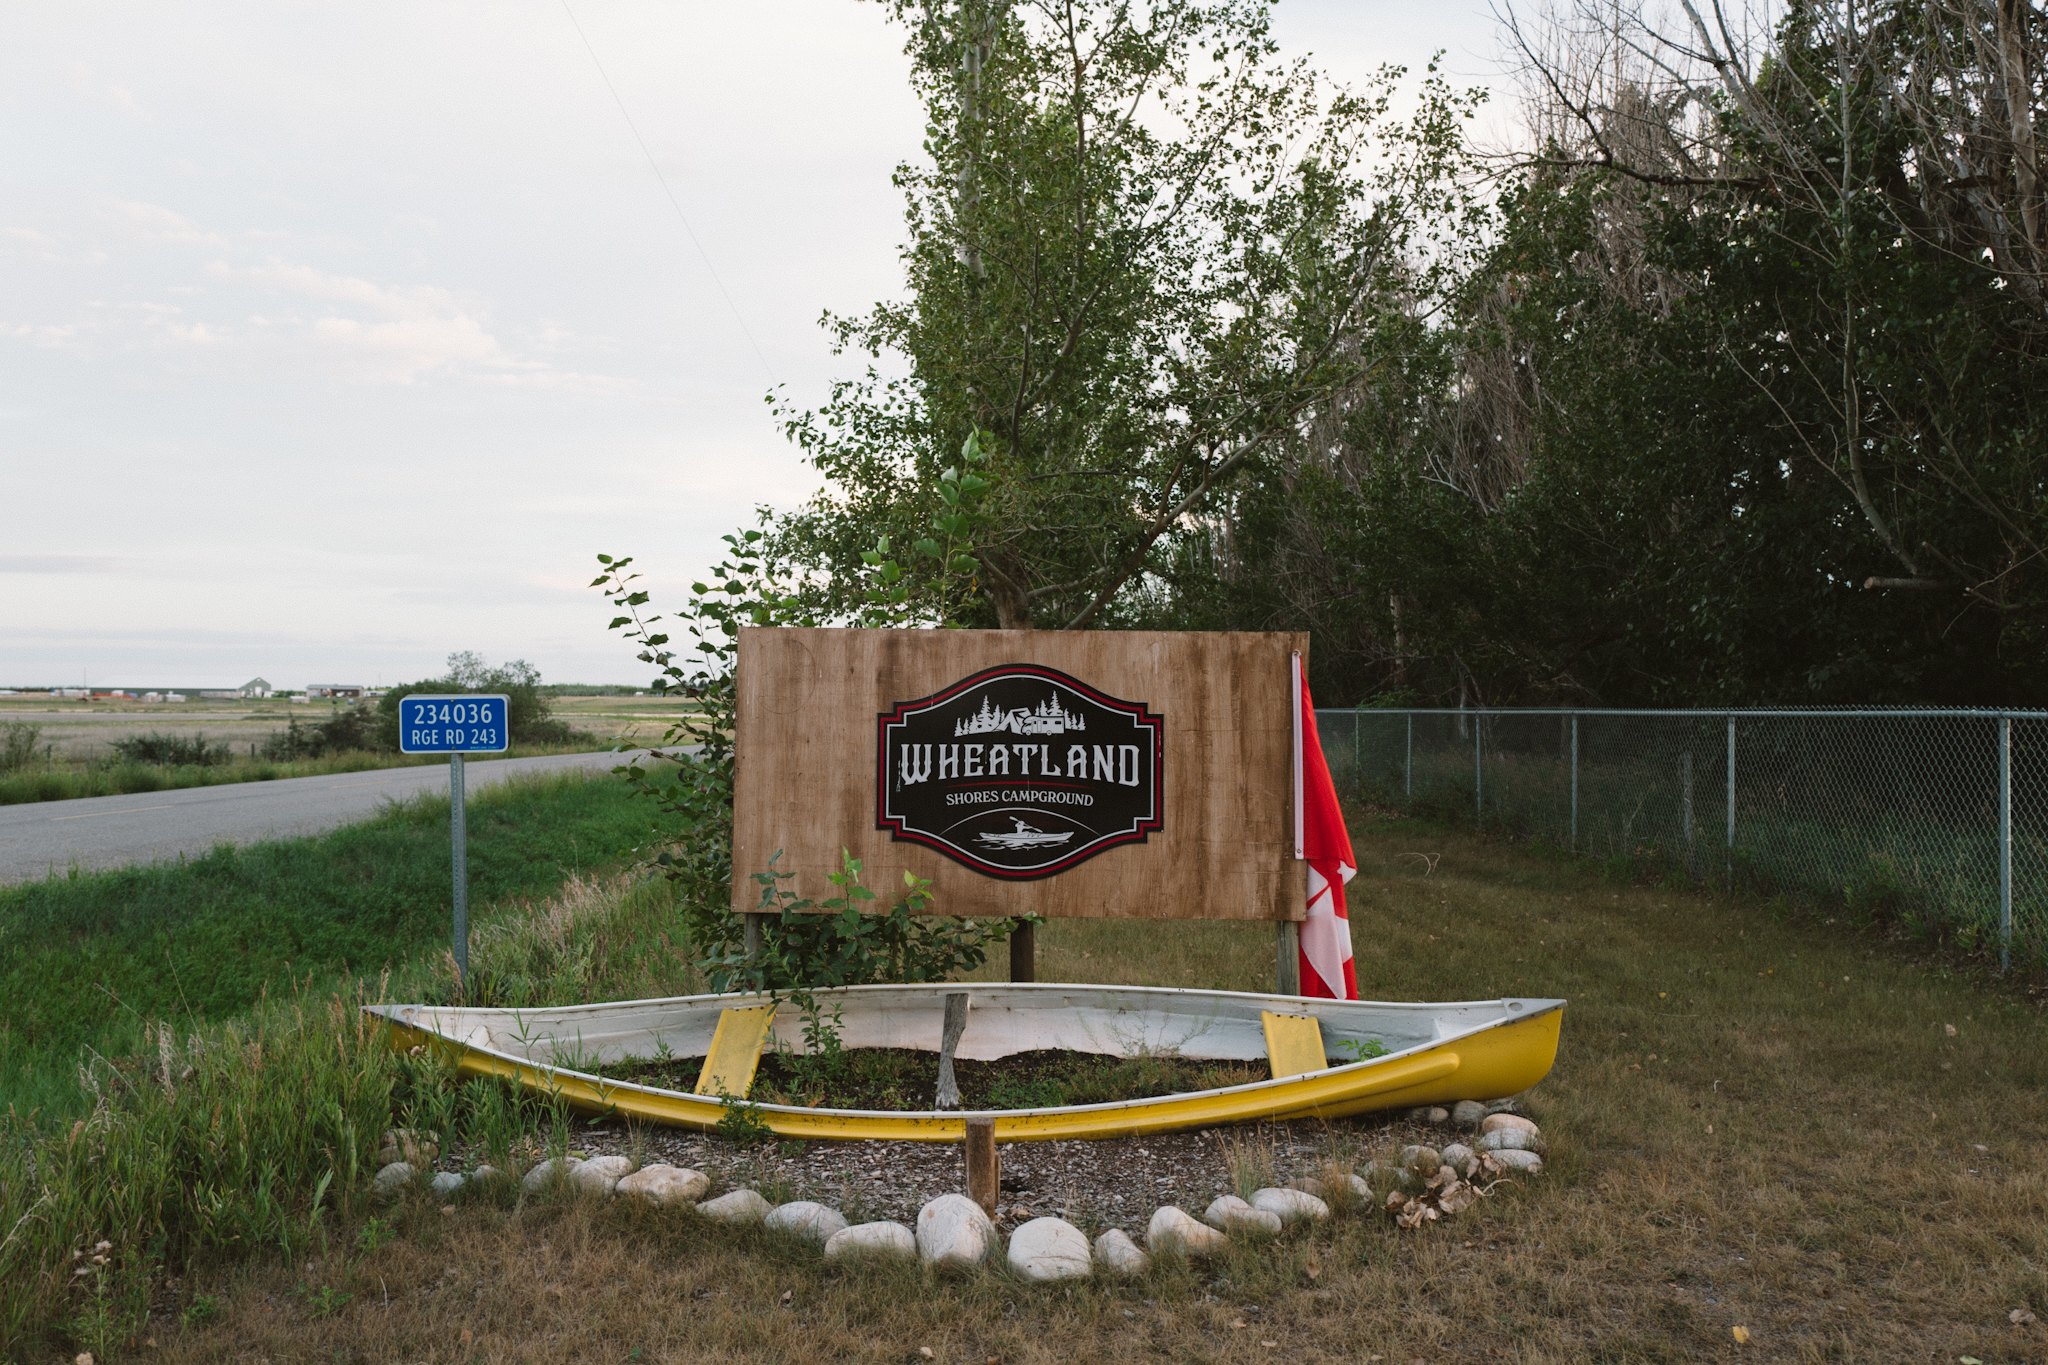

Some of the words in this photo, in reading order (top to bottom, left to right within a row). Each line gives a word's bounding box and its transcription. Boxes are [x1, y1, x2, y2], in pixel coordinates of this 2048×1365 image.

[414, 704, 493, 725] 234036
[412, 730, 439, 745] RGE
[446, 729, 466, 744] RD
[471, 729, 497, 744] 243
[900, 743, 1140, 787] WHEATLAND
[946, 790, 999, 806] SHORES
[1001, 790, 1094, 807] CAMPGROUND
